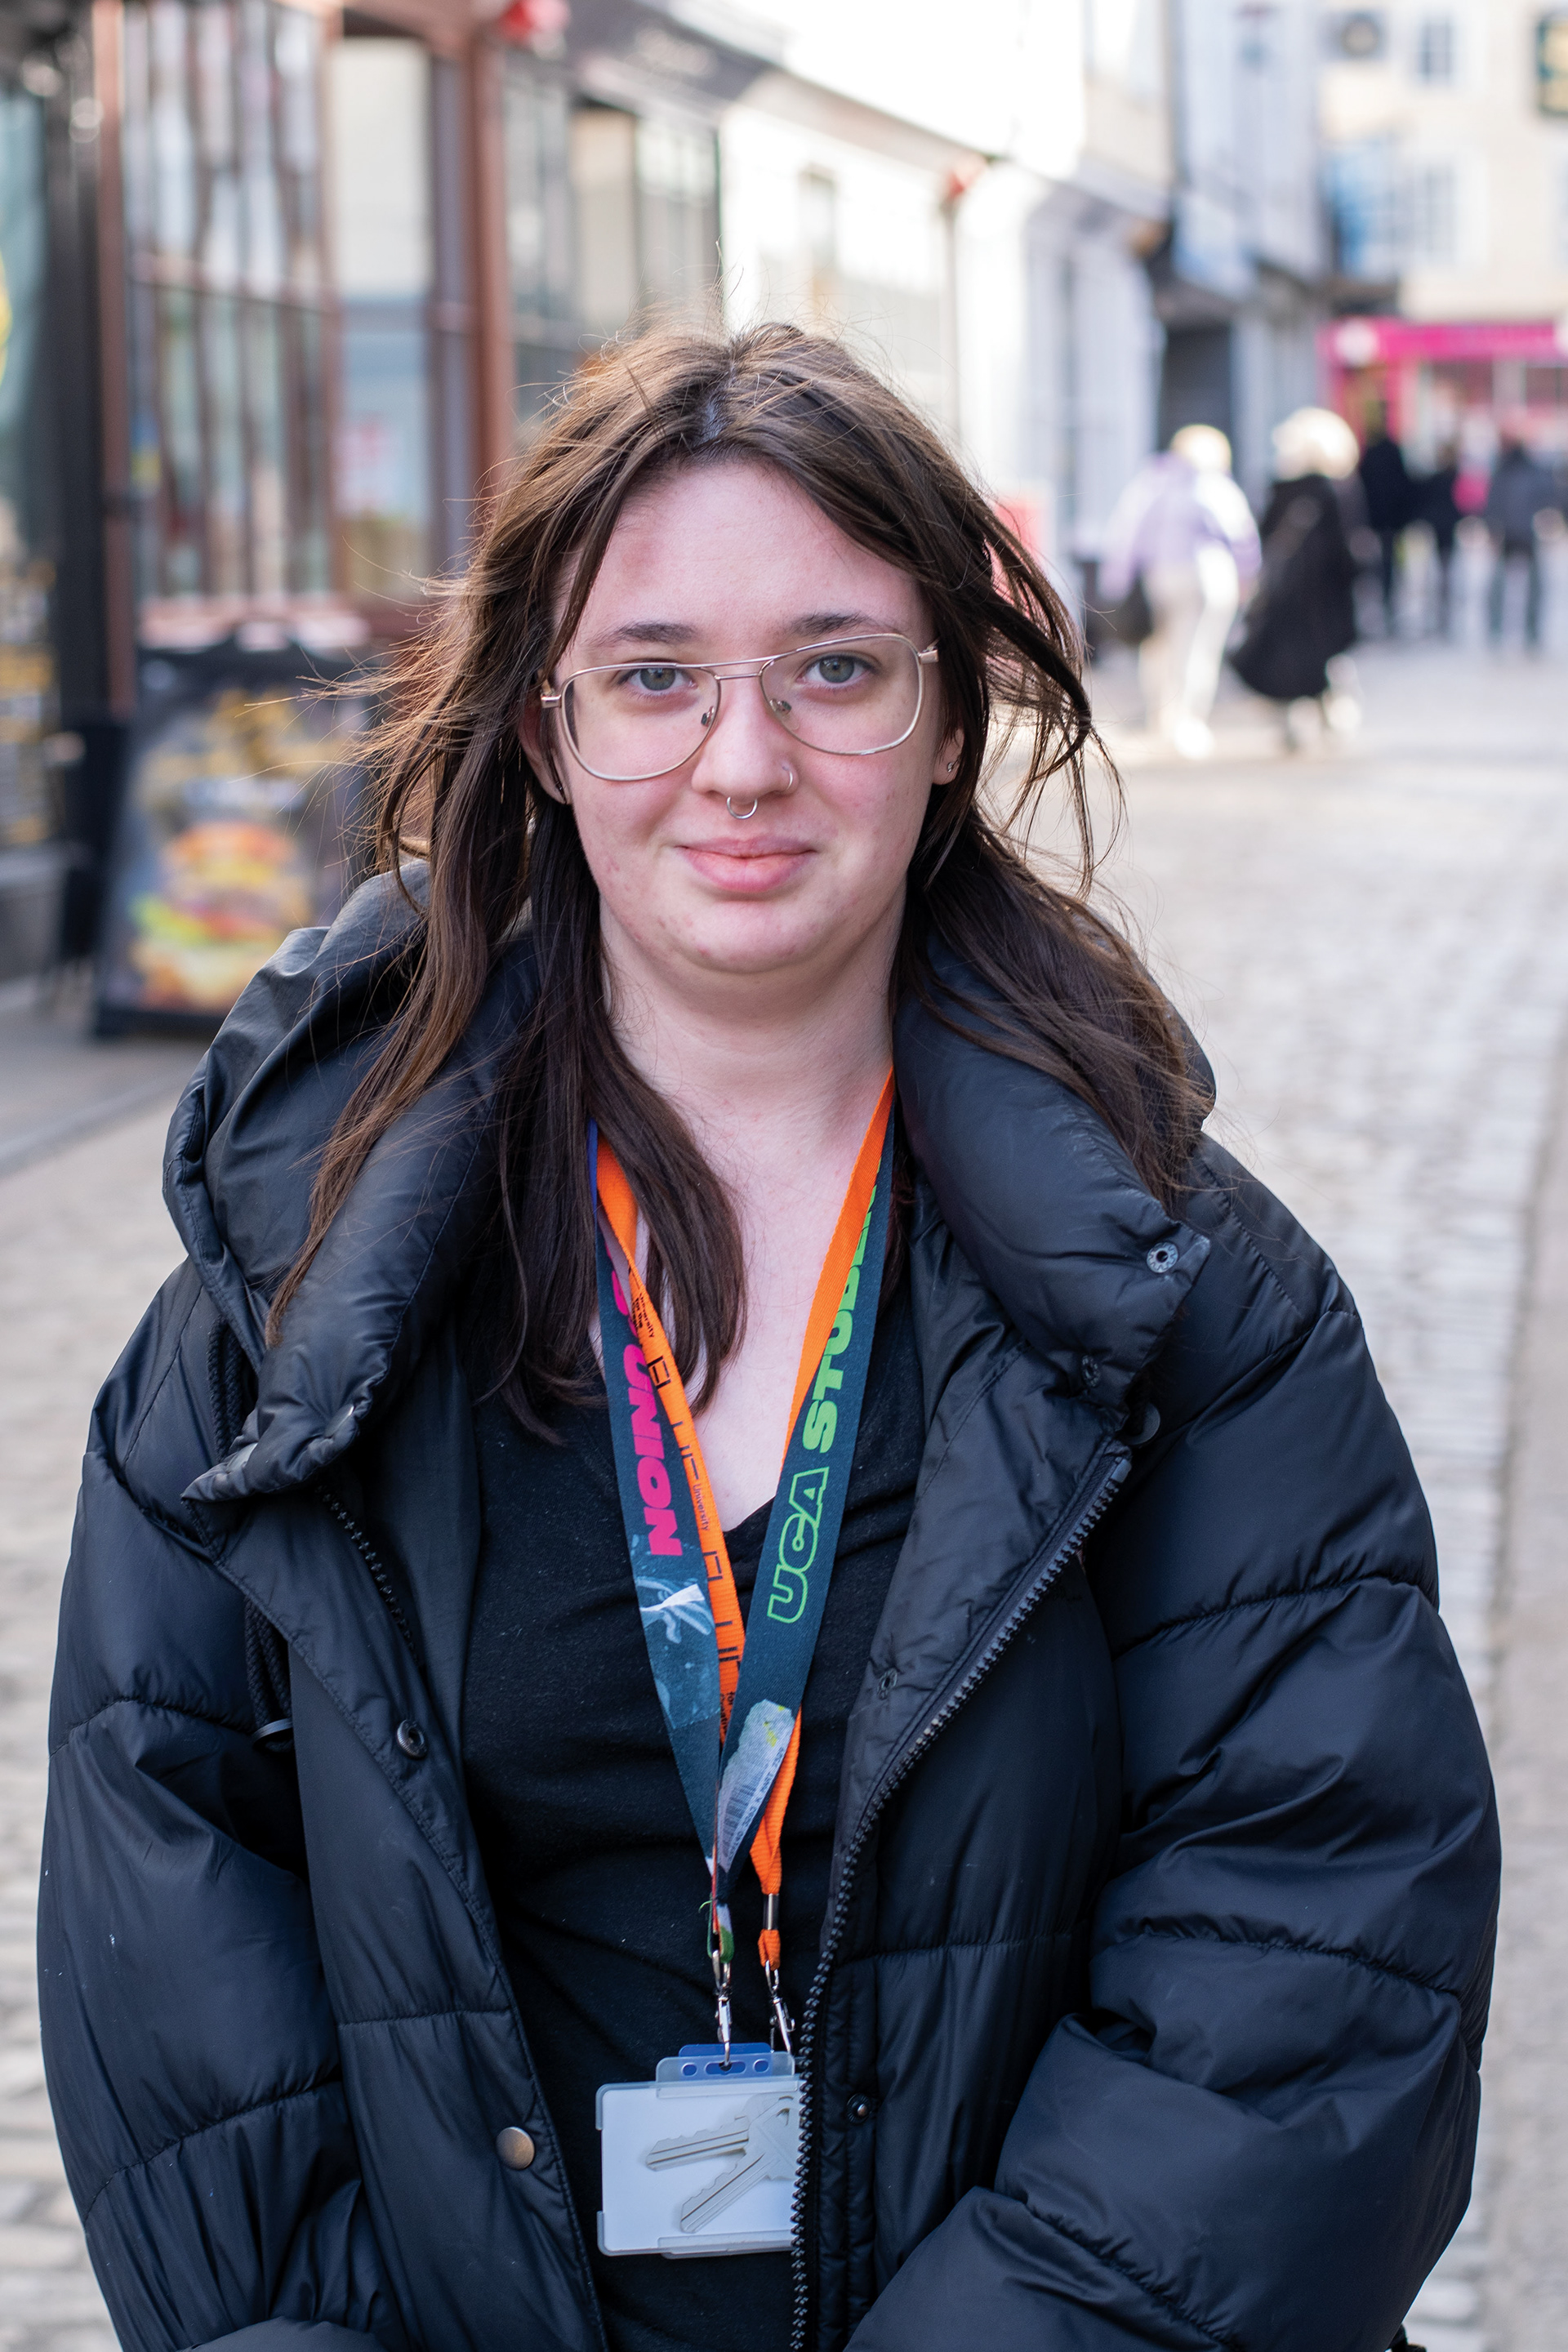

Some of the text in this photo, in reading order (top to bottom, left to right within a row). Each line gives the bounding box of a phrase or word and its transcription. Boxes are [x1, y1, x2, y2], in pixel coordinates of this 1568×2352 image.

[623, 1343, 683, 1557] UNION
[693, 1483, 710, 1531] University
[767, 1467, 830, 1624] UCA
